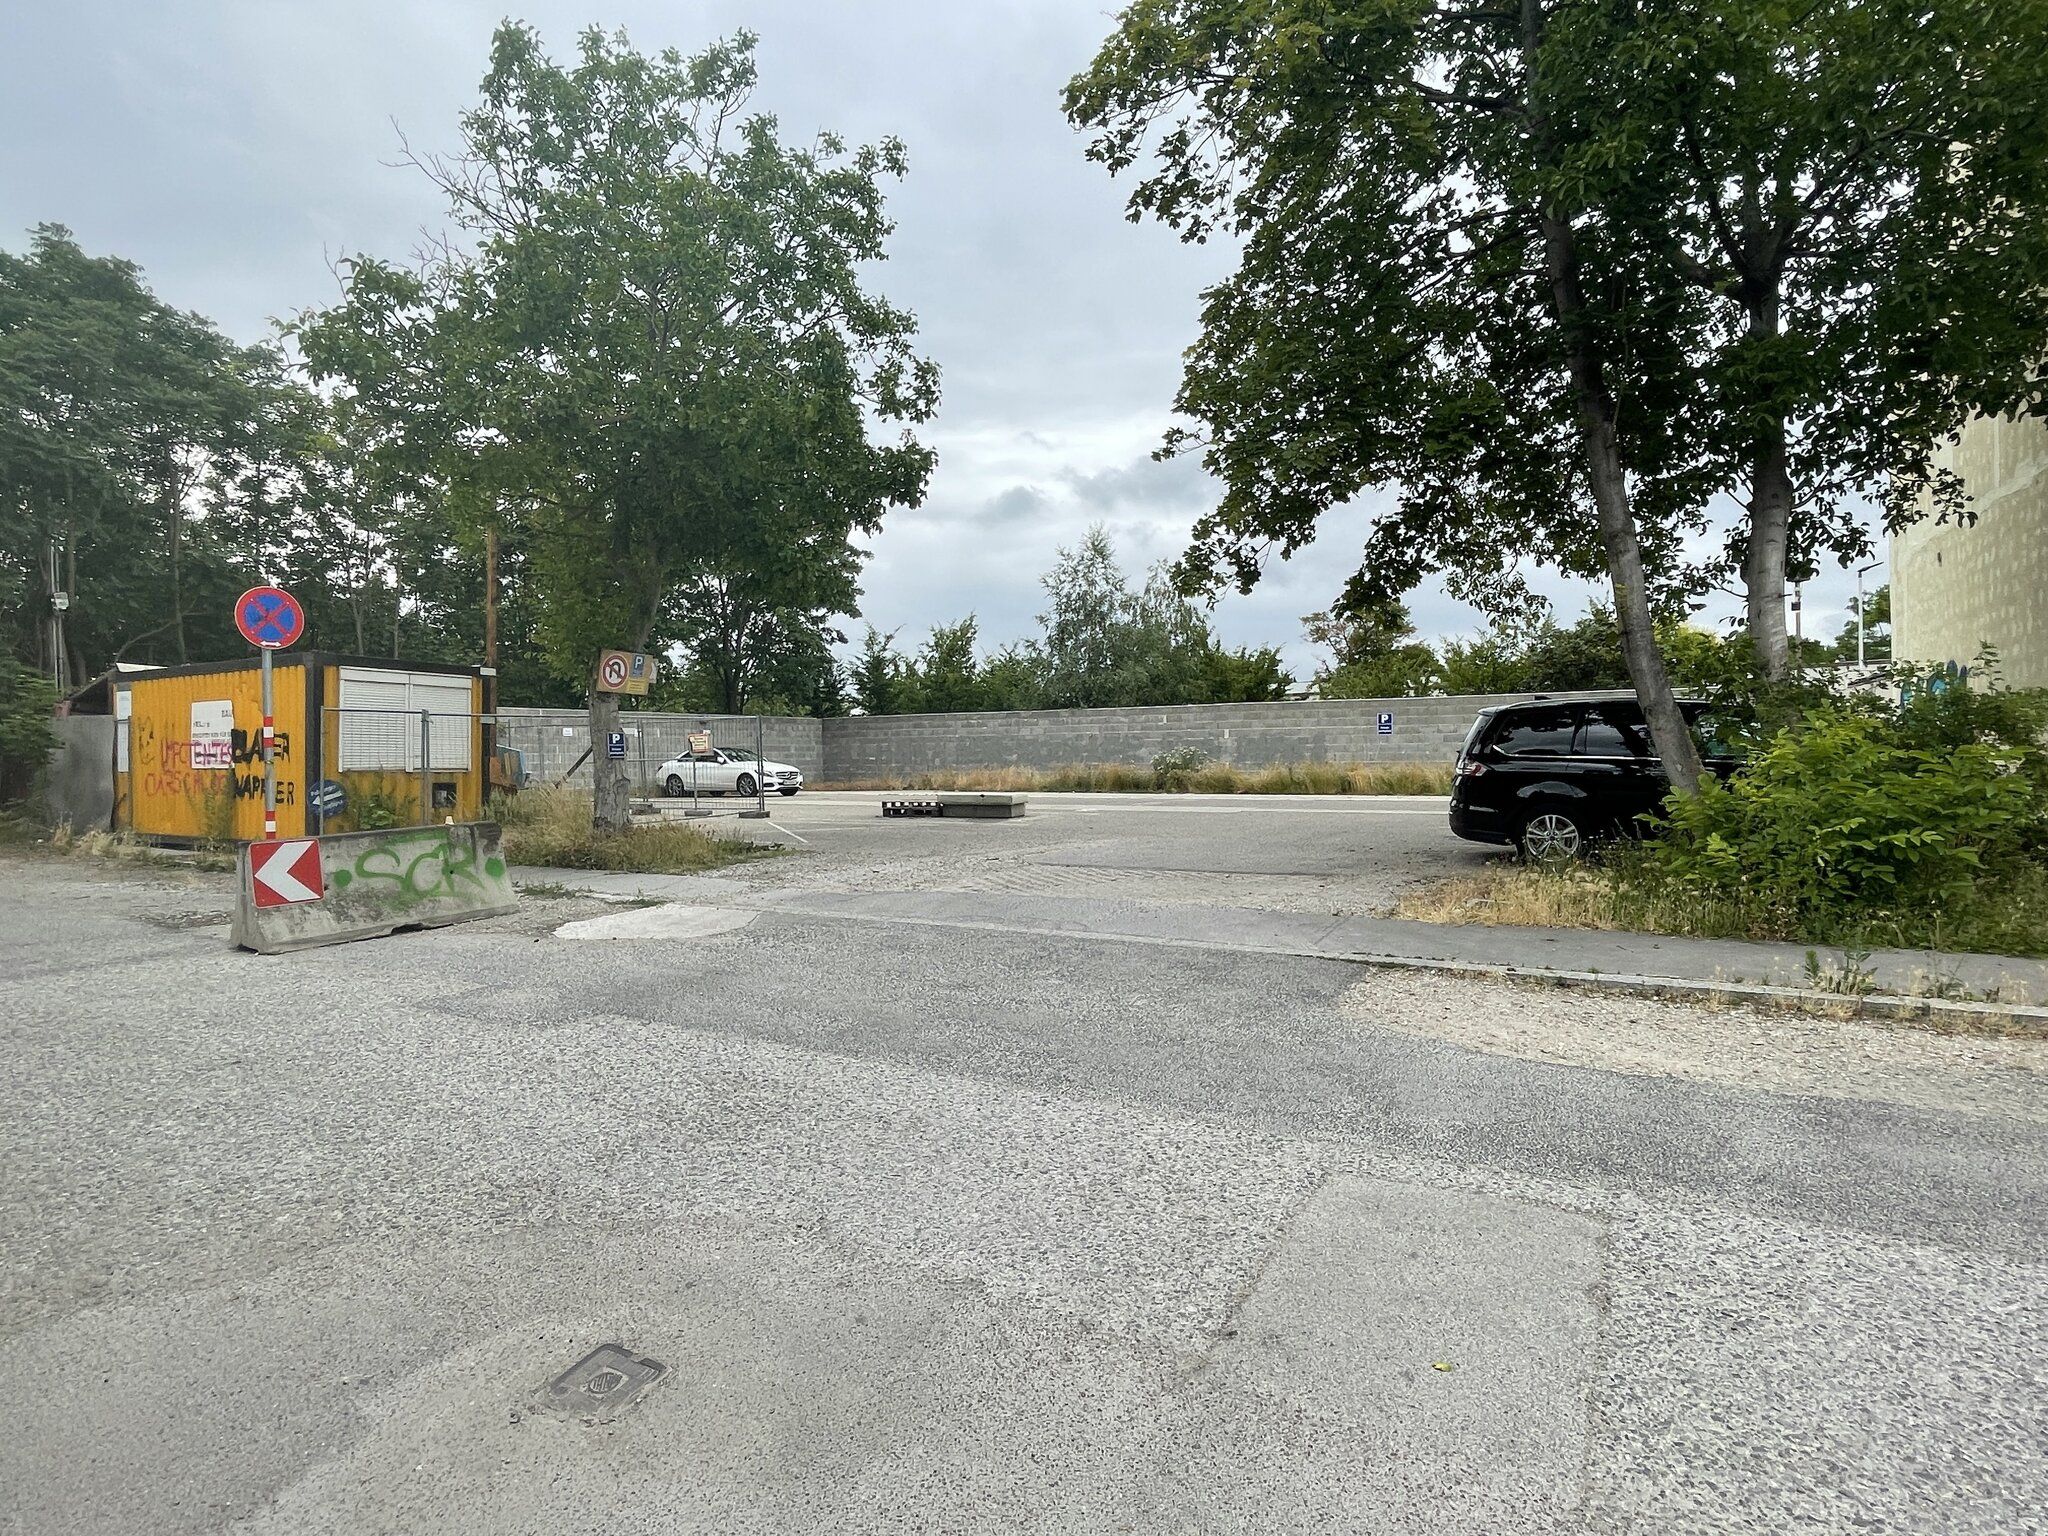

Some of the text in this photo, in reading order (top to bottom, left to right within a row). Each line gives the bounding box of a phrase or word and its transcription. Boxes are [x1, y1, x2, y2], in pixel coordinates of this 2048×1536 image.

[634, 656, 643, 669] P
[1381, 714, 1389, 724] P
[612, 733, 621, 744] P
